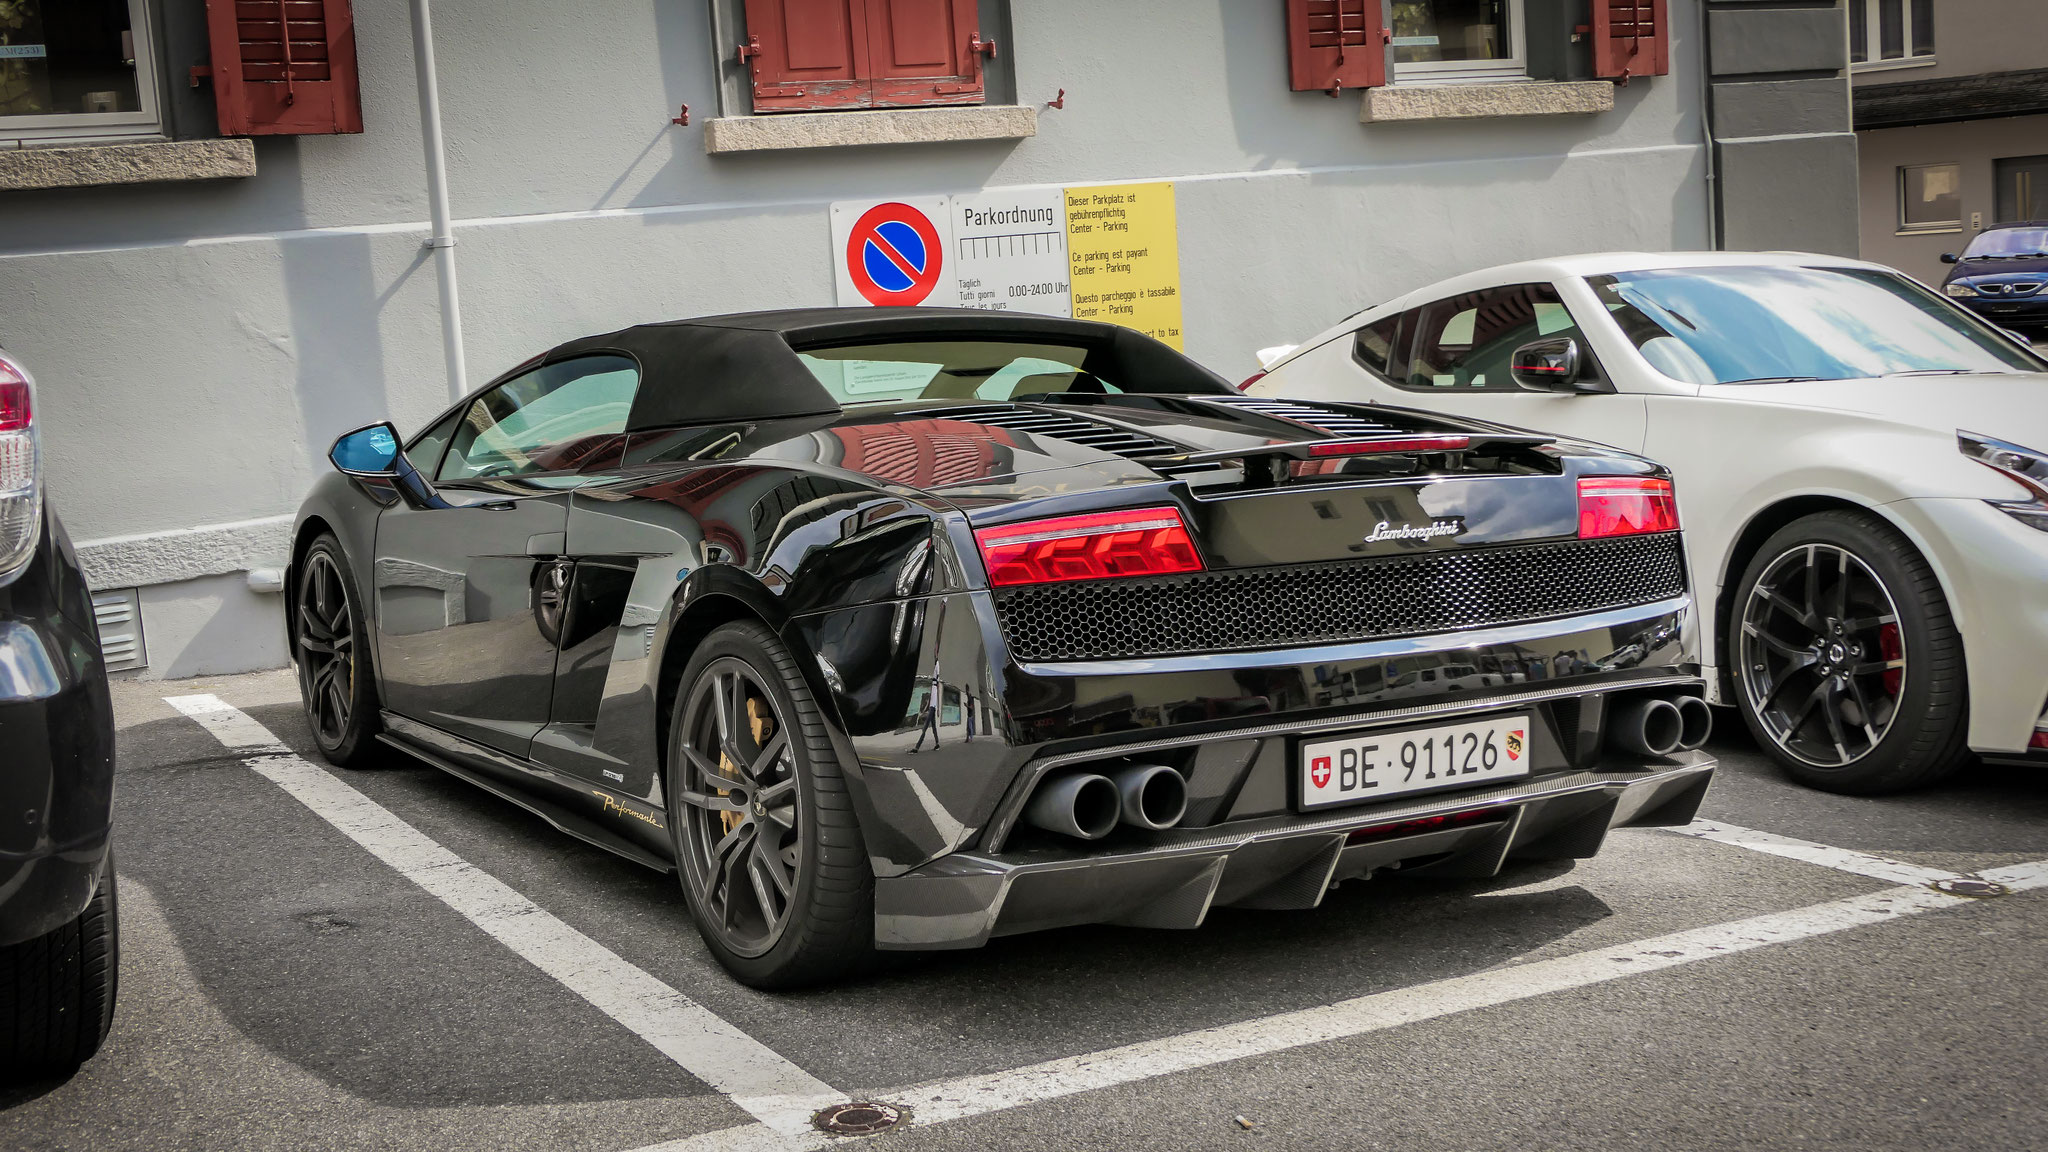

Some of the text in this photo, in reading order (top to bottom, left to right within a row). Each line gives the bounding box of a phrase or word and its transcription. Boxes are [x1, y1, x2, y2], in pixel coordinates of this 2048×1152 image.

[1068, 193, 1136, 207] Dieser Parkplatz ist
[965, 206, 1053, 226] Parkordnung
[1069, 208, 1126, 222] gebührenpflichtig
[1070, 224, 1092, 234] Center
[1103, 221, 1129, 232] Parking
[1072, 247, 1149, 263] Ce parking est payant
[1073, 265, 1095, 276] Center
[1106, 263, 1131, 274] Parking
[960, 291, 995, 301] Tutti giorni
[1009, 282, 1068, 297] 0.00-24.00 Uhr
[1075, 293, 1098, 304] Questo
[1101, 291, 1136, 304] parcheggio
[1147, 286, 1176, 298] tassabile
[1076, 307, 1098, 318] Center
[1109, 304, 1134, 315] Parking
[1158, 328, 1166, 338] to
[1168, 327, 1179, 337] tax
[1364, 520, 1459, 542] Lamborghini
[592, 790, 664, 829] Performante
